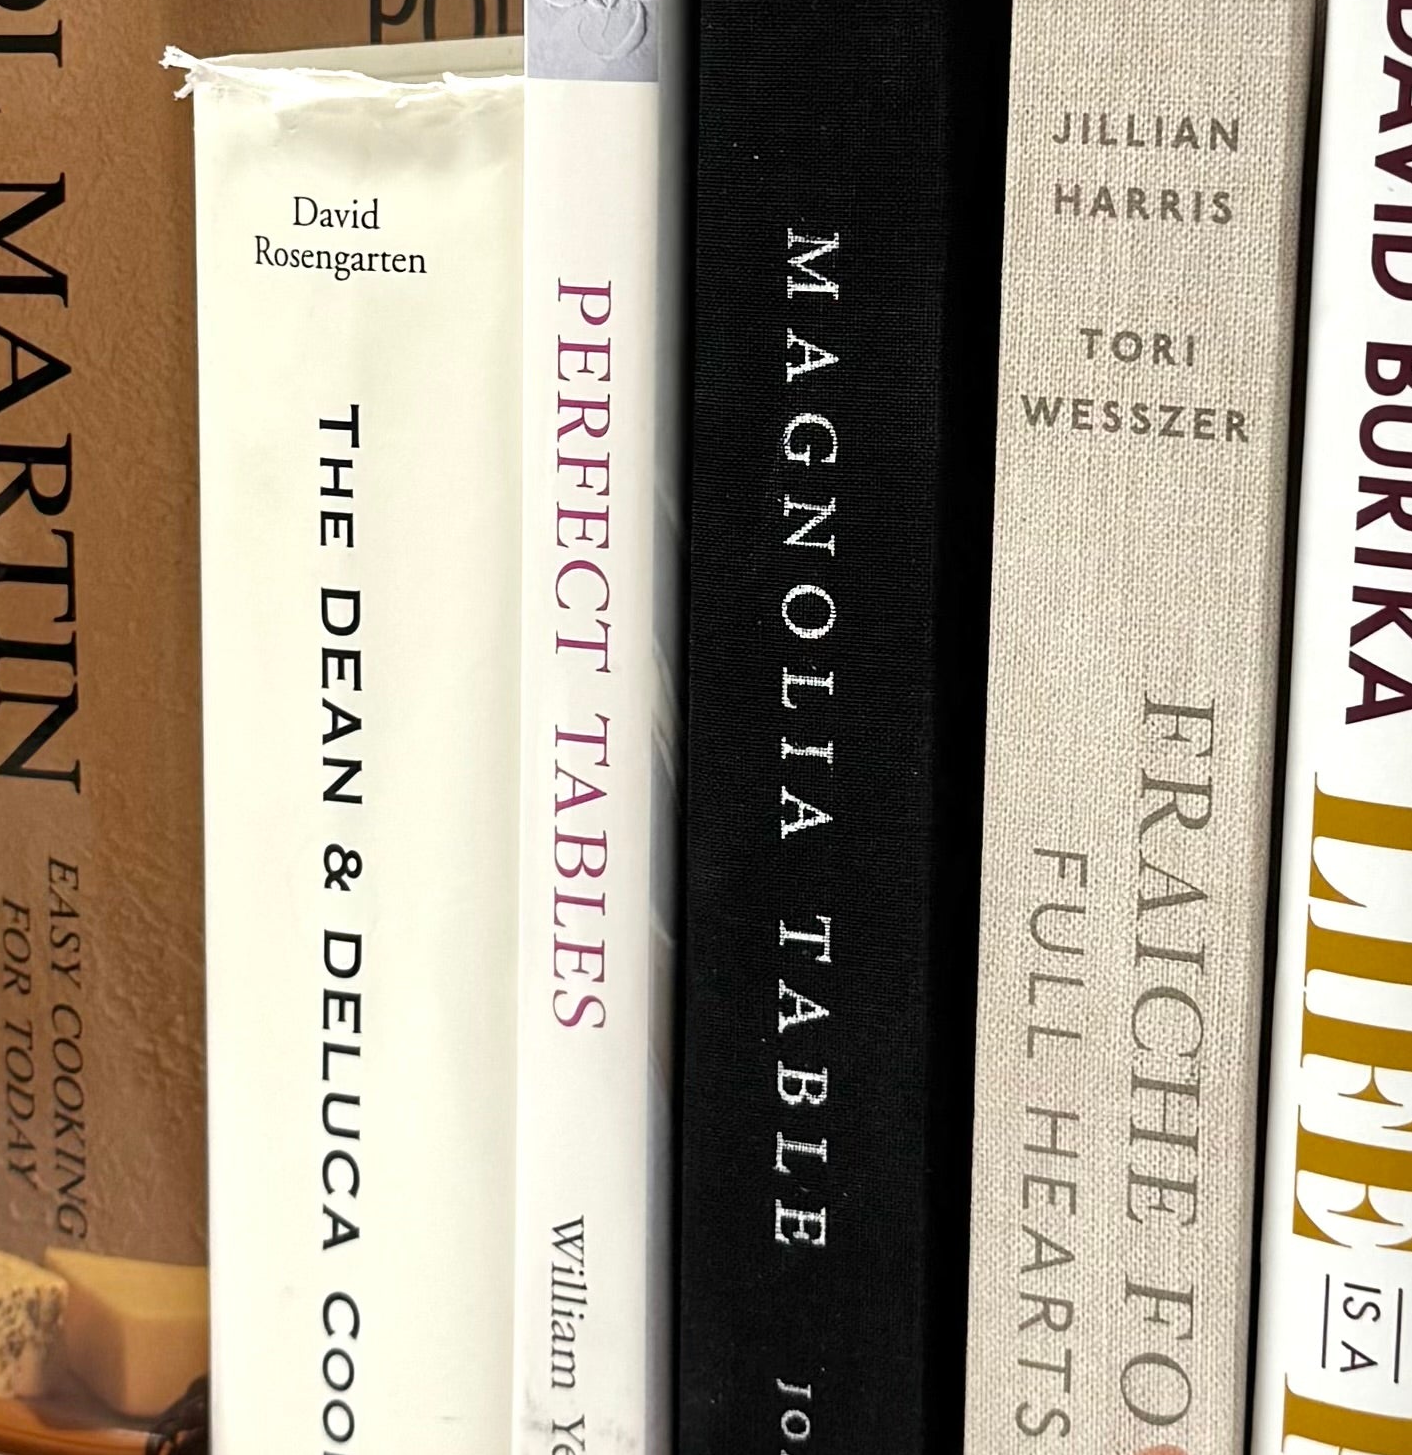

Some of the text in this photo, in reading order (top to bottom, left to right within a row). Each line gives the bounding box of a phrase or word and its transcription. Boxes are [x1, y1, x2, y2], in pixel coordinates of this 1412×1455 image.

[1051, 110, 1241, 154] JILLIAN
[253, 234, 428, 281] Rosengarten
[291, 195, 381, 231] David
[1053, 184, 1235, 226] HARRIS
[1019, 393, 1250, 445] WESSZER
[1079, 328, 1197, 369] TORI
[318, 403, 361, 548] THE
[319, 586, 364, 805] DEAN
[551, 276, 613, 1032] PERFECT TABLES
[773, 226, 840, 1248] MAGNOLIA TABLE
[322, 843, 363, 892] &
[1125, 690, 1217, 1228] FRAICHE
[1, 896, 39, 1193] FOR TODAY
[47, 854, 87, 1240] EASY COOKING
[321, 928, 362, 1252] DELUCA
[1015, 847, 1089, 1442] FULL HEARTS
[550, 1213, 588, 1390] William
[1339, 1339, 1379, 1374] A
[1342, 1281, 1383, 1323] IS
